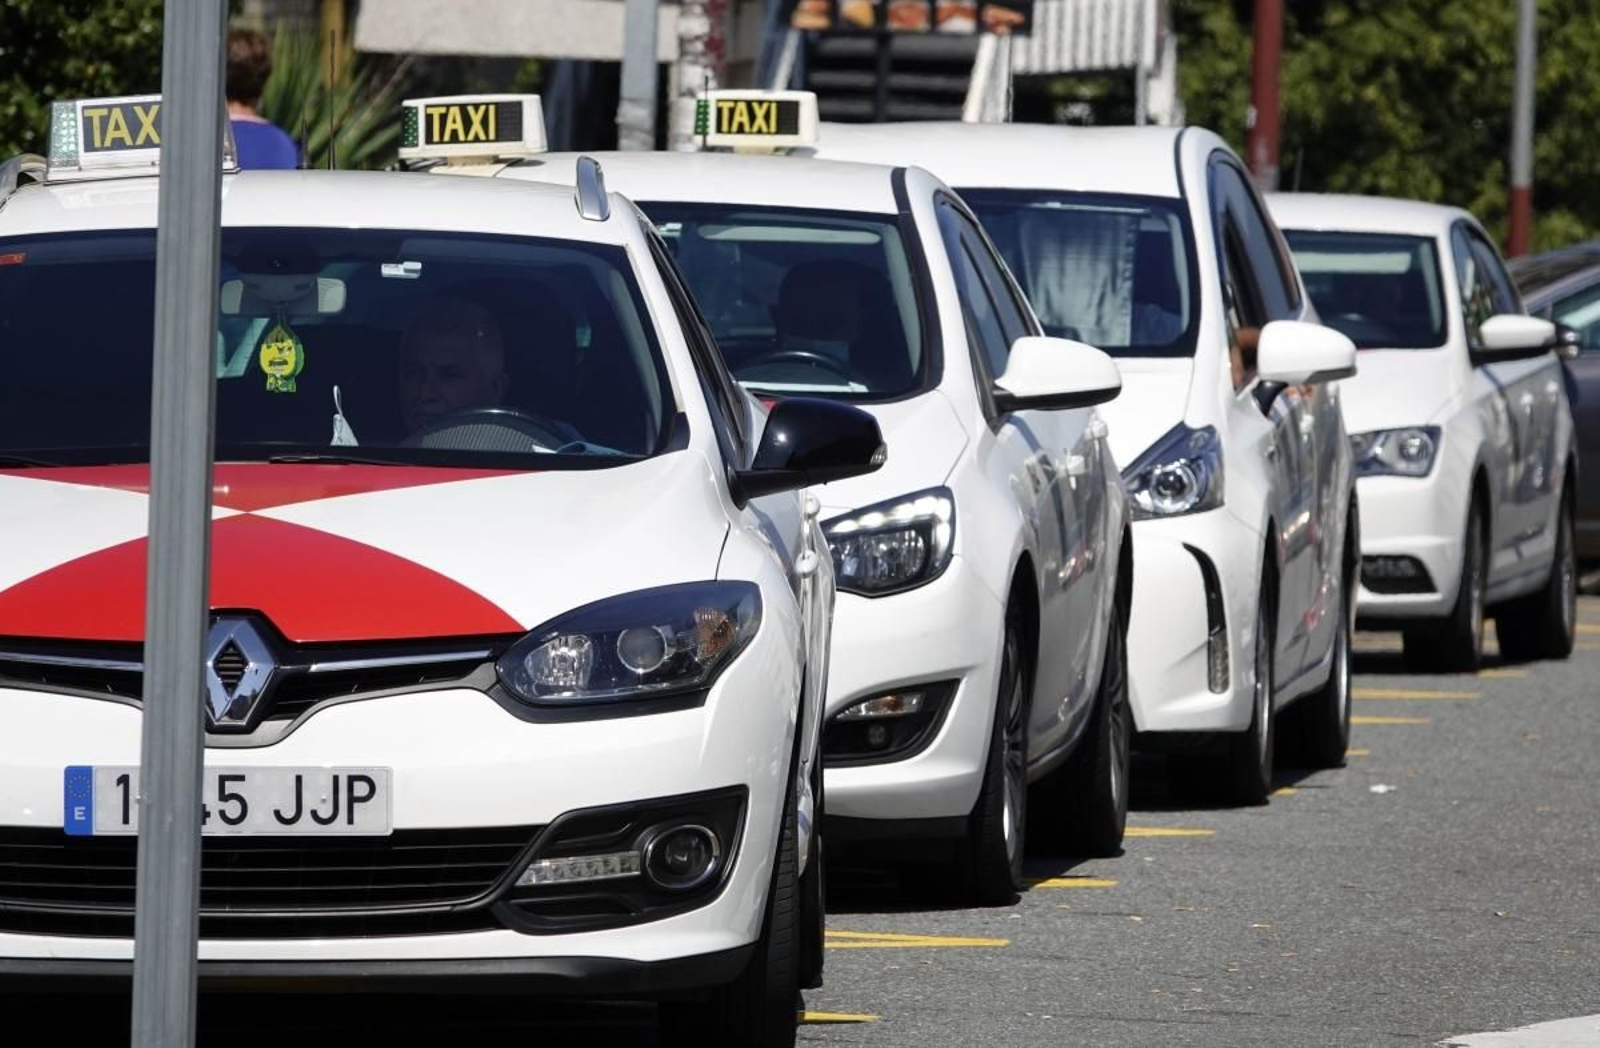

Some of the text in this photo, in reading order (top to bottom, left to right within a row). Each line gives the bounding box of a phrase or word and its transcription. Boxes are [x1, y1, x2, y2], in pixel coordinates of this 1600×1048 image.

[84, 105, 160, 148] TAX
[426, 104, 496, 142] TAXI
[718, 101, 777, 133] TAXI
[74, 807, 86, 821] E
[116, 774, 377, 826] 15 JJP
